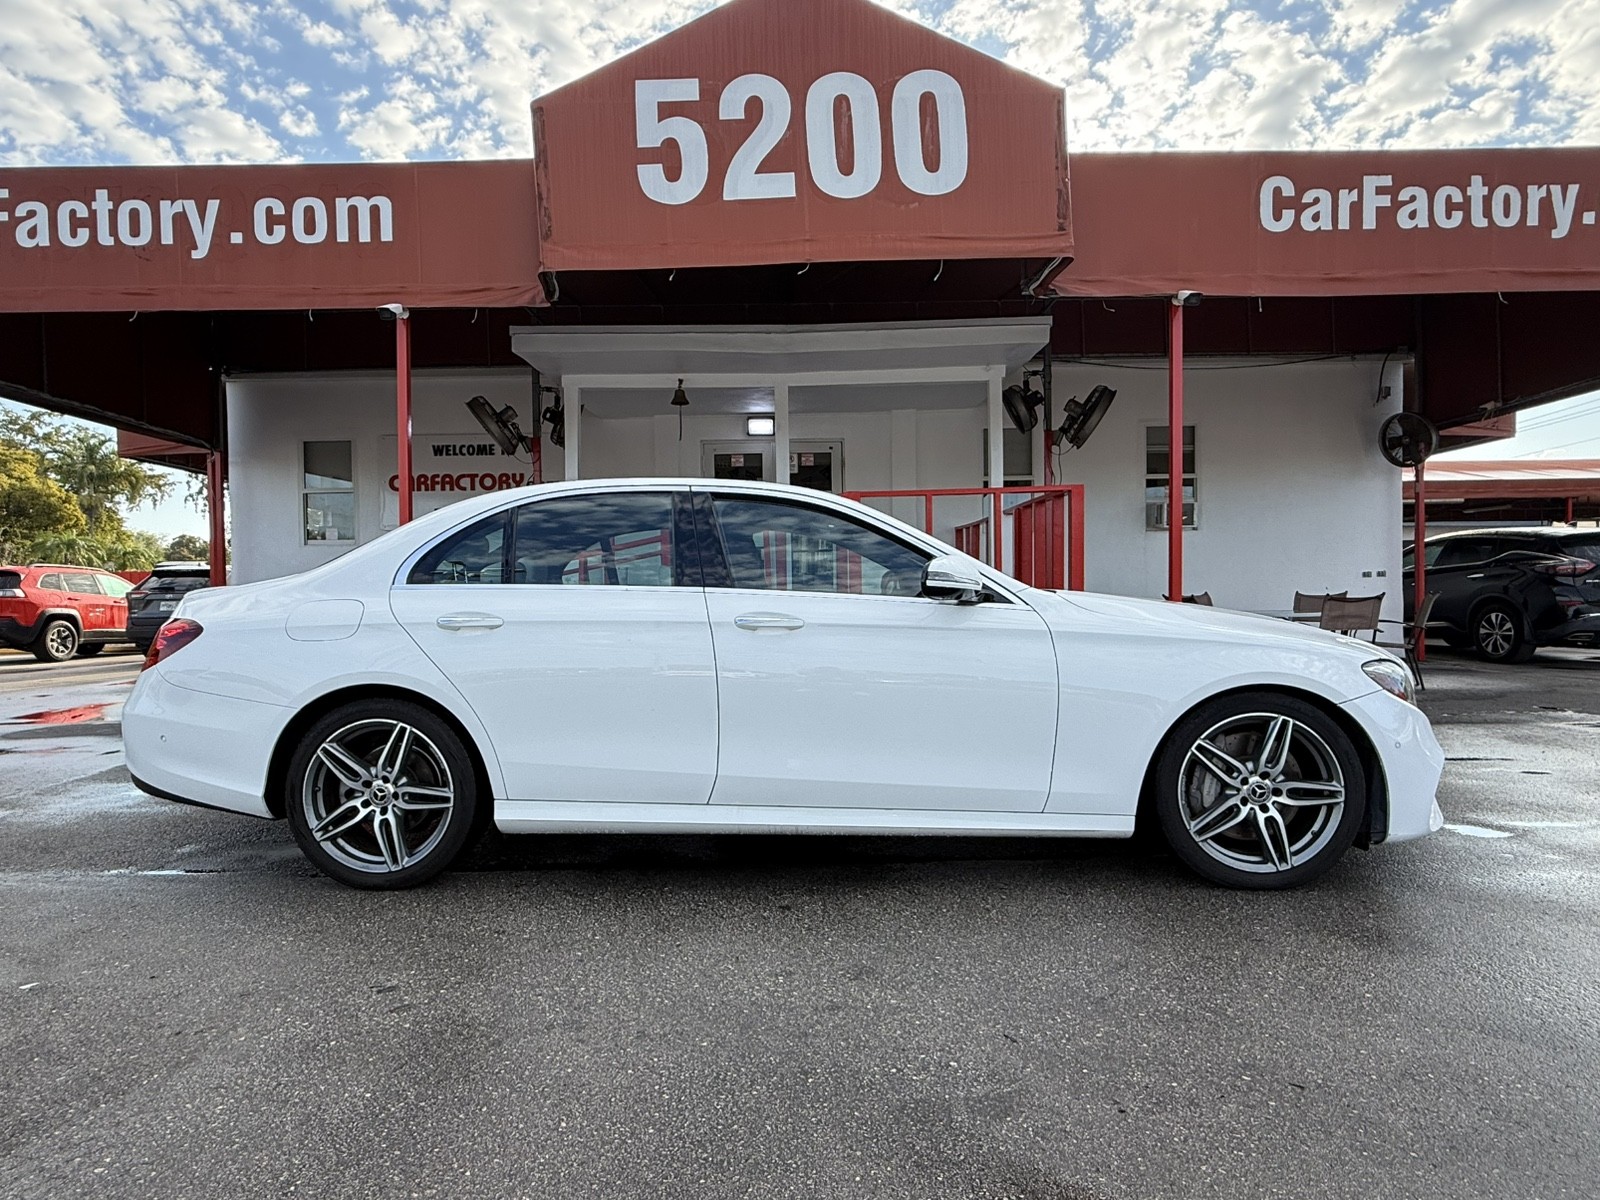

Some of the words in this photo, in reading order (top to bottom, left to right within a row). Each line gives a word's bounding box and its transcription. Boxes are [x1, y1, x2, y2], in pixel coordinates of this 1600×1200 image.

[635, 69, 968, 205] 5200
[0, 188, 394, 260] actory.com
[432, 444, 496, 457] WELCOME
[388, 473, 525, 492] CRFACTORY
